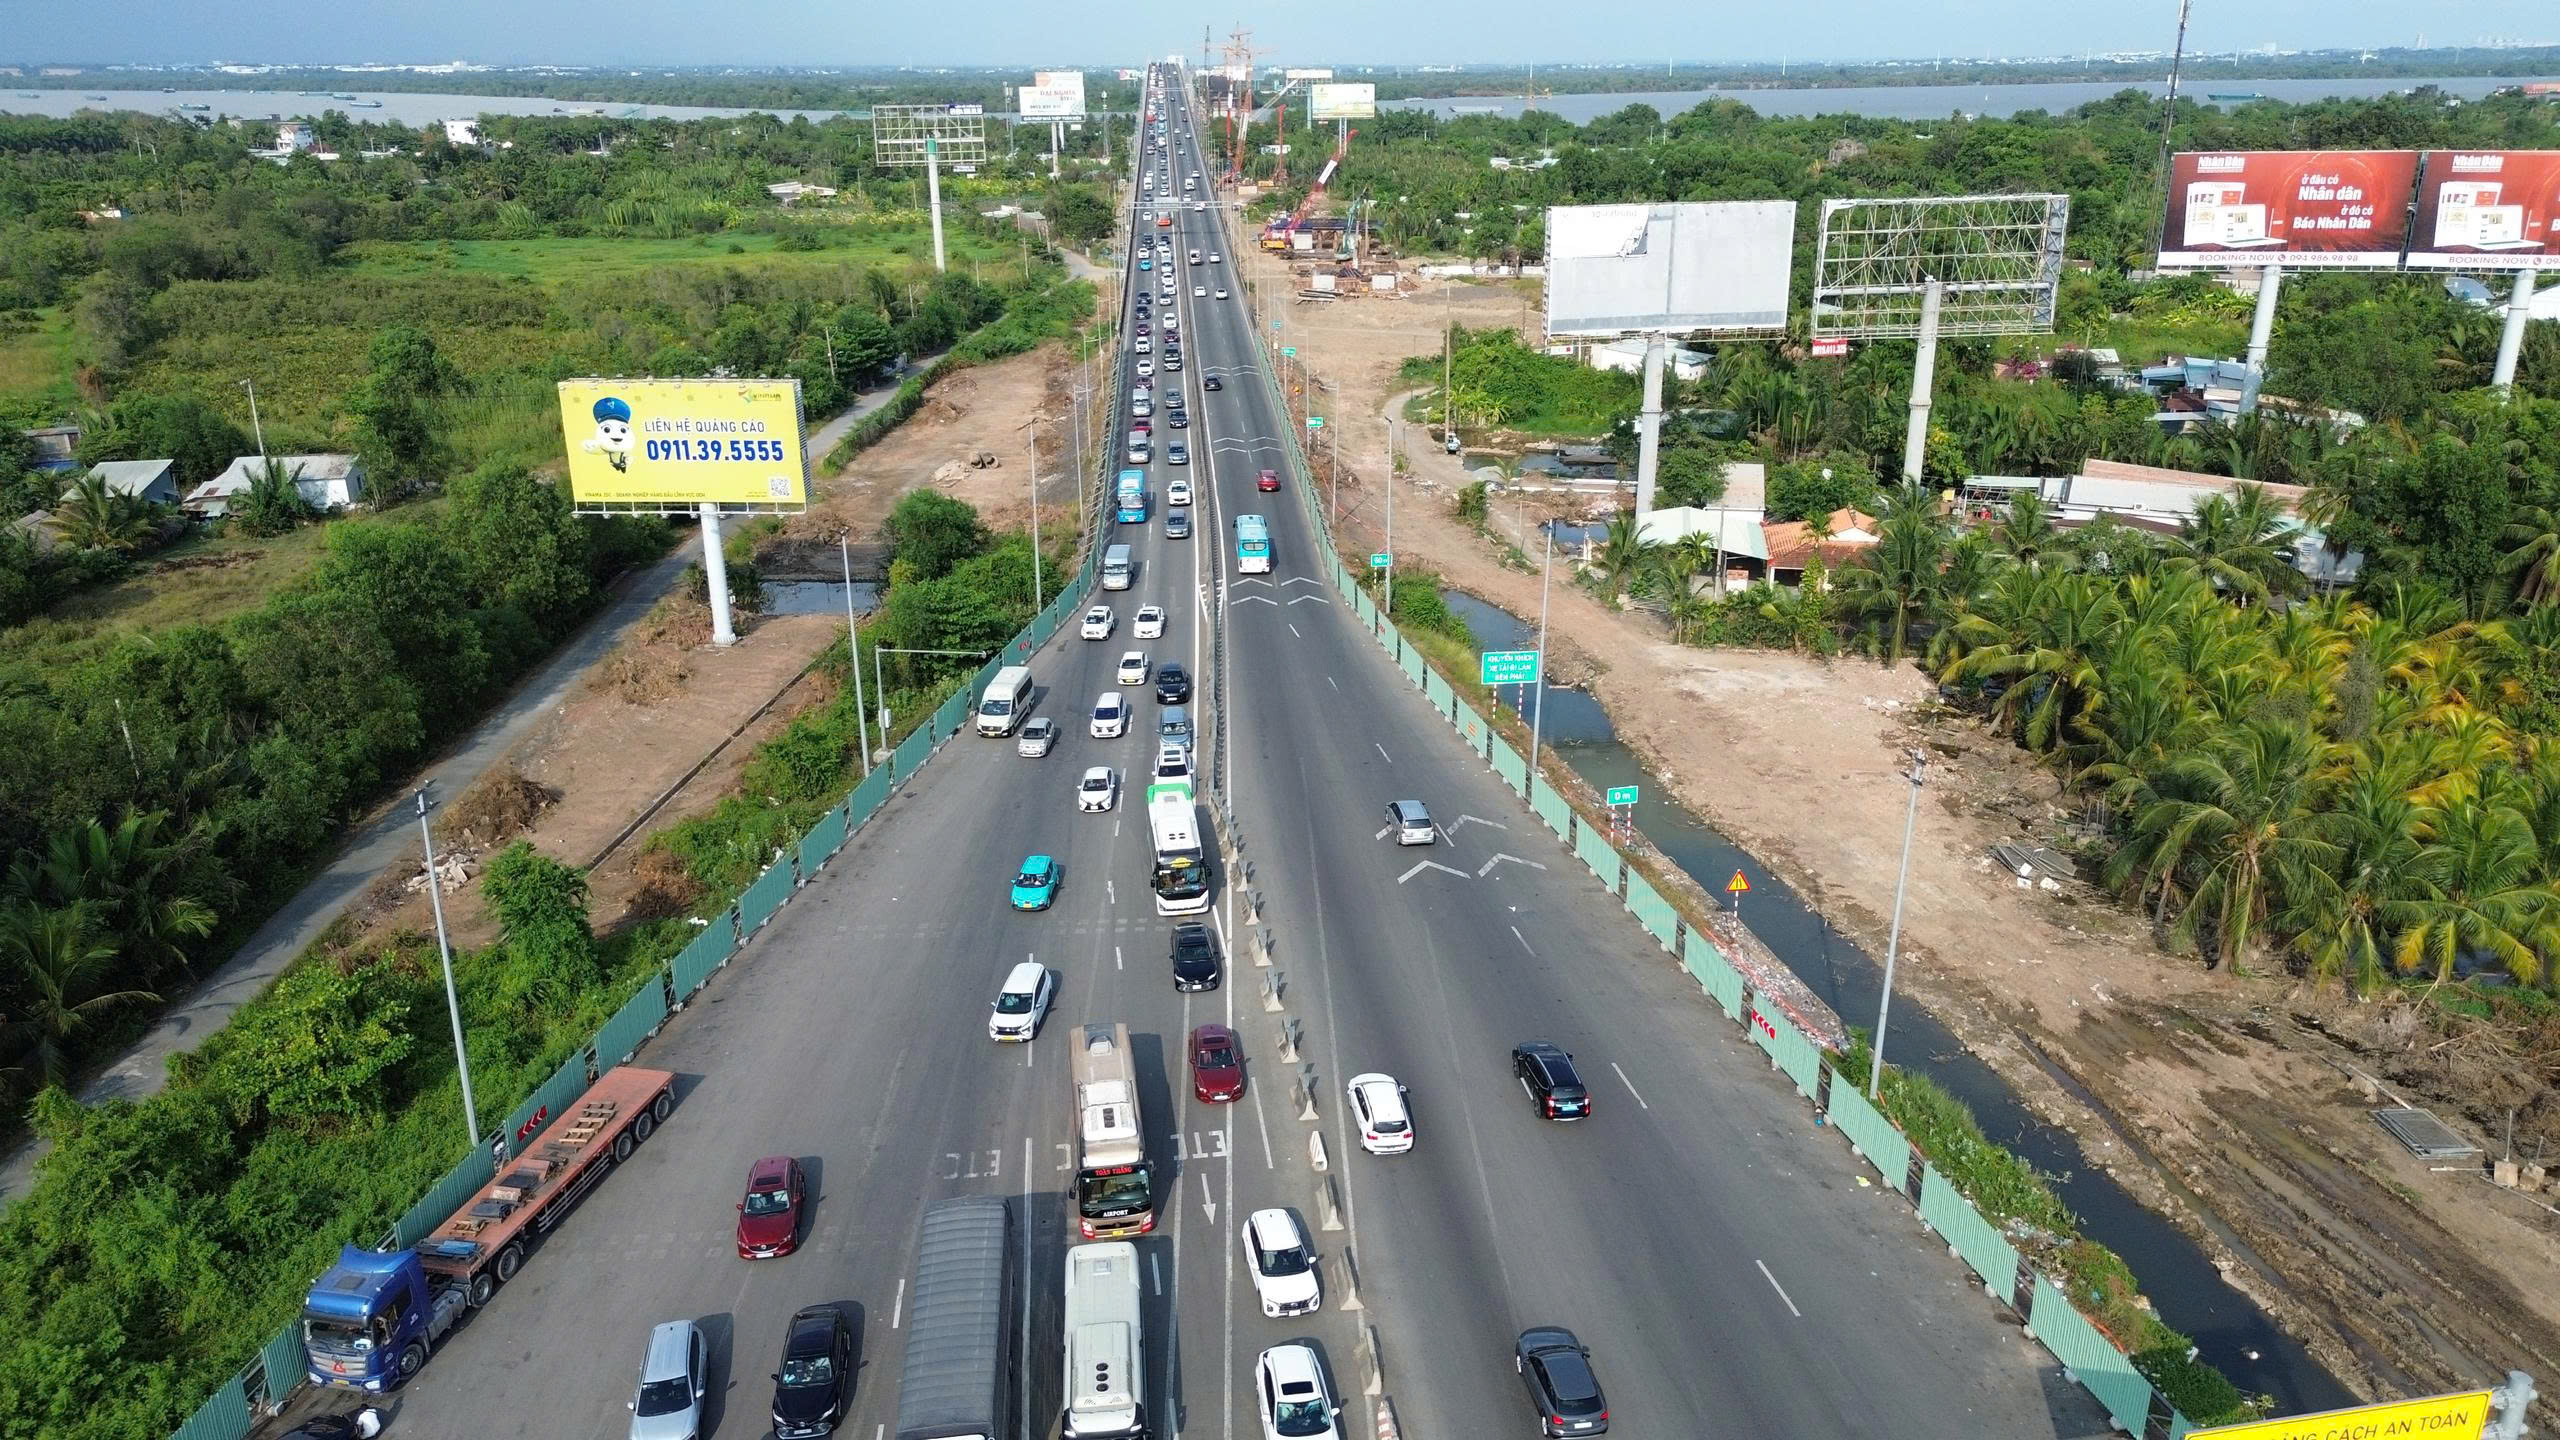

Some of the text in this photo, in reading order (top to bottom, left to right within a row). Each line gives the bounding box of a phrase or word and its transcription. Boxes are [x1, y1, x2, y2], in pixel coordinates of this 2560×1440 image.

[2309, 174, 2326, 185] đâu
[2327, 174, 2340, 185] có
[2298, 185, 2362, 201] Nhân dân
[2362, 205, 2374, 216] có
[2293, 216, 2371, 229] Báo Nhân Dân
[2503, 257, 2529, 265] NOW
[645, 417, 671, 432] LIÊN
[647, 439, 783, 461] 0911.39.5555
[1170, 1130, 1227, 1161] ETC
[943, 1149, 1000, 1179] ETC
[1103, 1209, 1129, 1217] AIRPORT
[2384, 1419, 2412, 1435] AN
